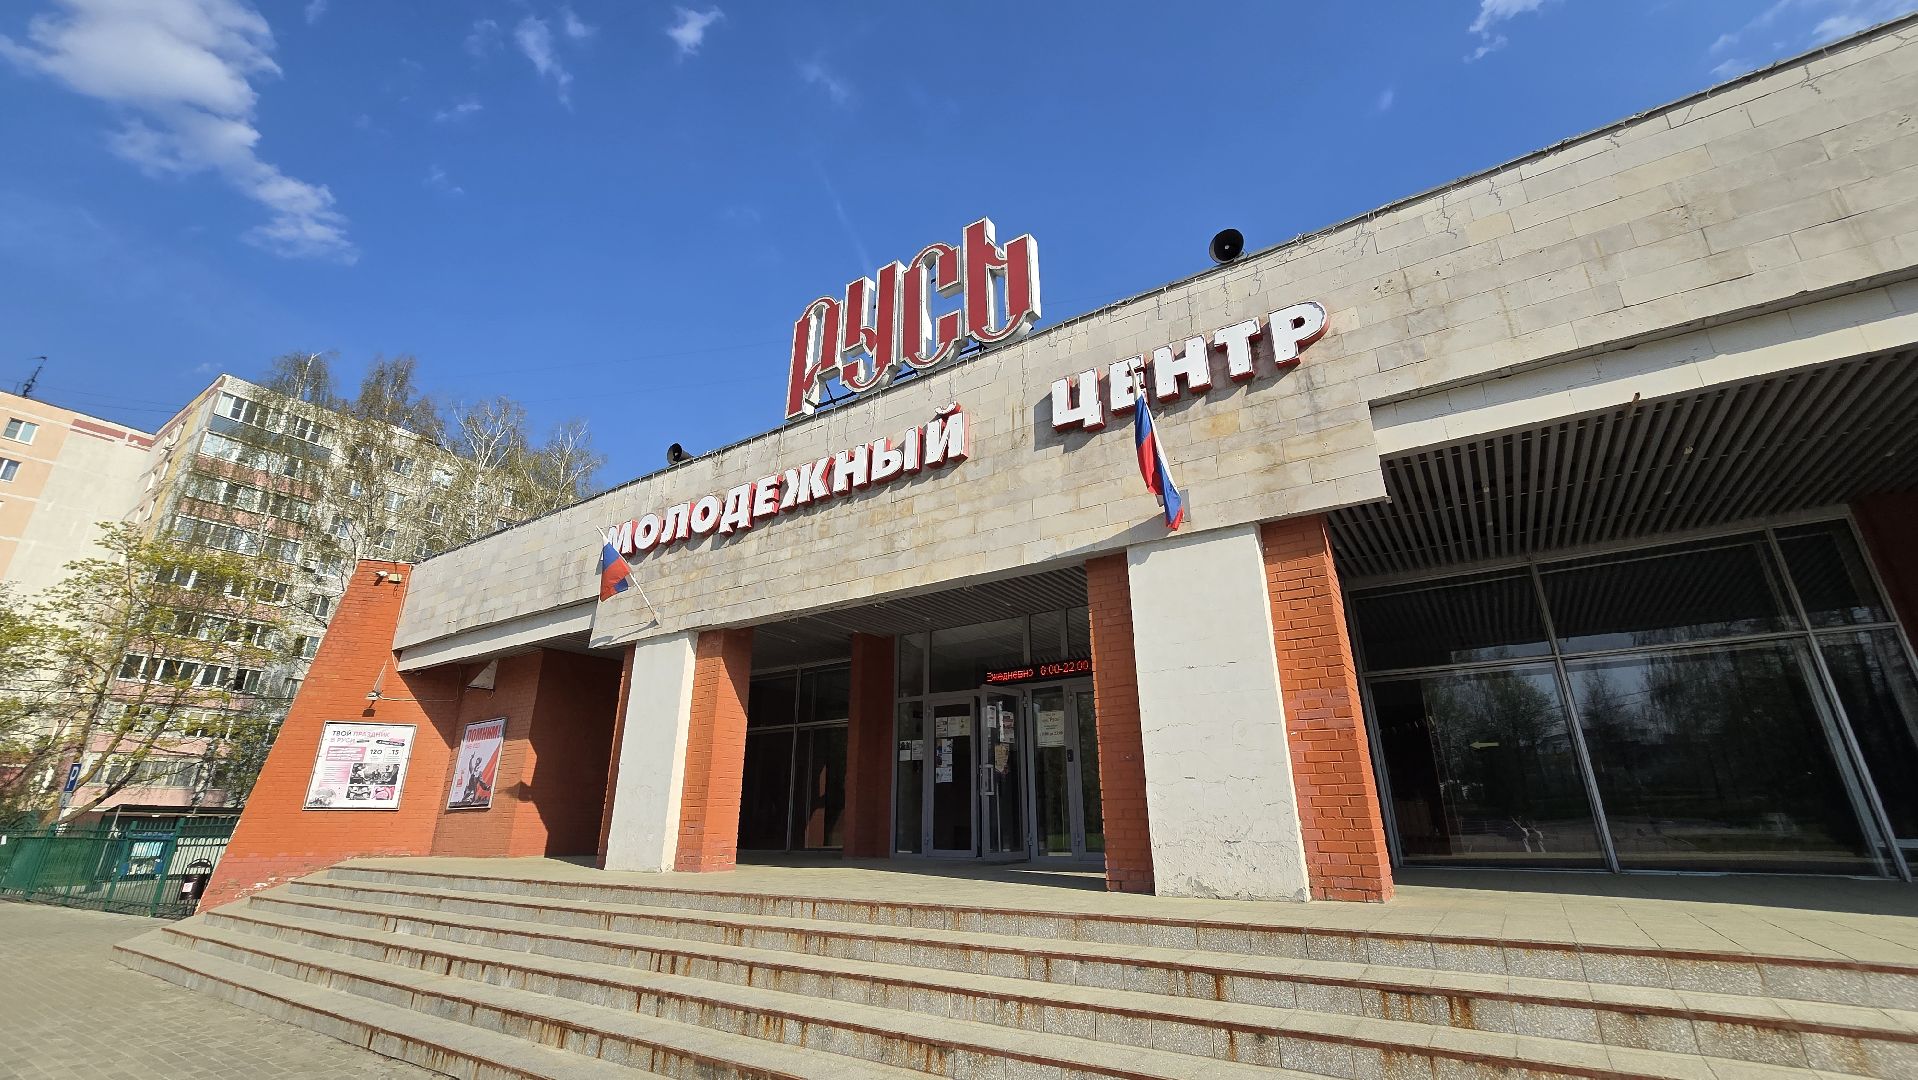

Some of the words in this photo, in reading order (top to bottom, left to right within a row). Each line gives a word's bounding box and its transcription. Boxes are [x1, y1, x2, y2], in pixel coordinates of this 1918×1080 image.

[785, 216, 1041, 421] РУСЬ
[607, 401, 970, 554] МОЛОДЕЖНЫЙ
[1051, 300, 1330, 433] ЦЕНТР
[467, 724, 501, 743] ПОМНИМ!
